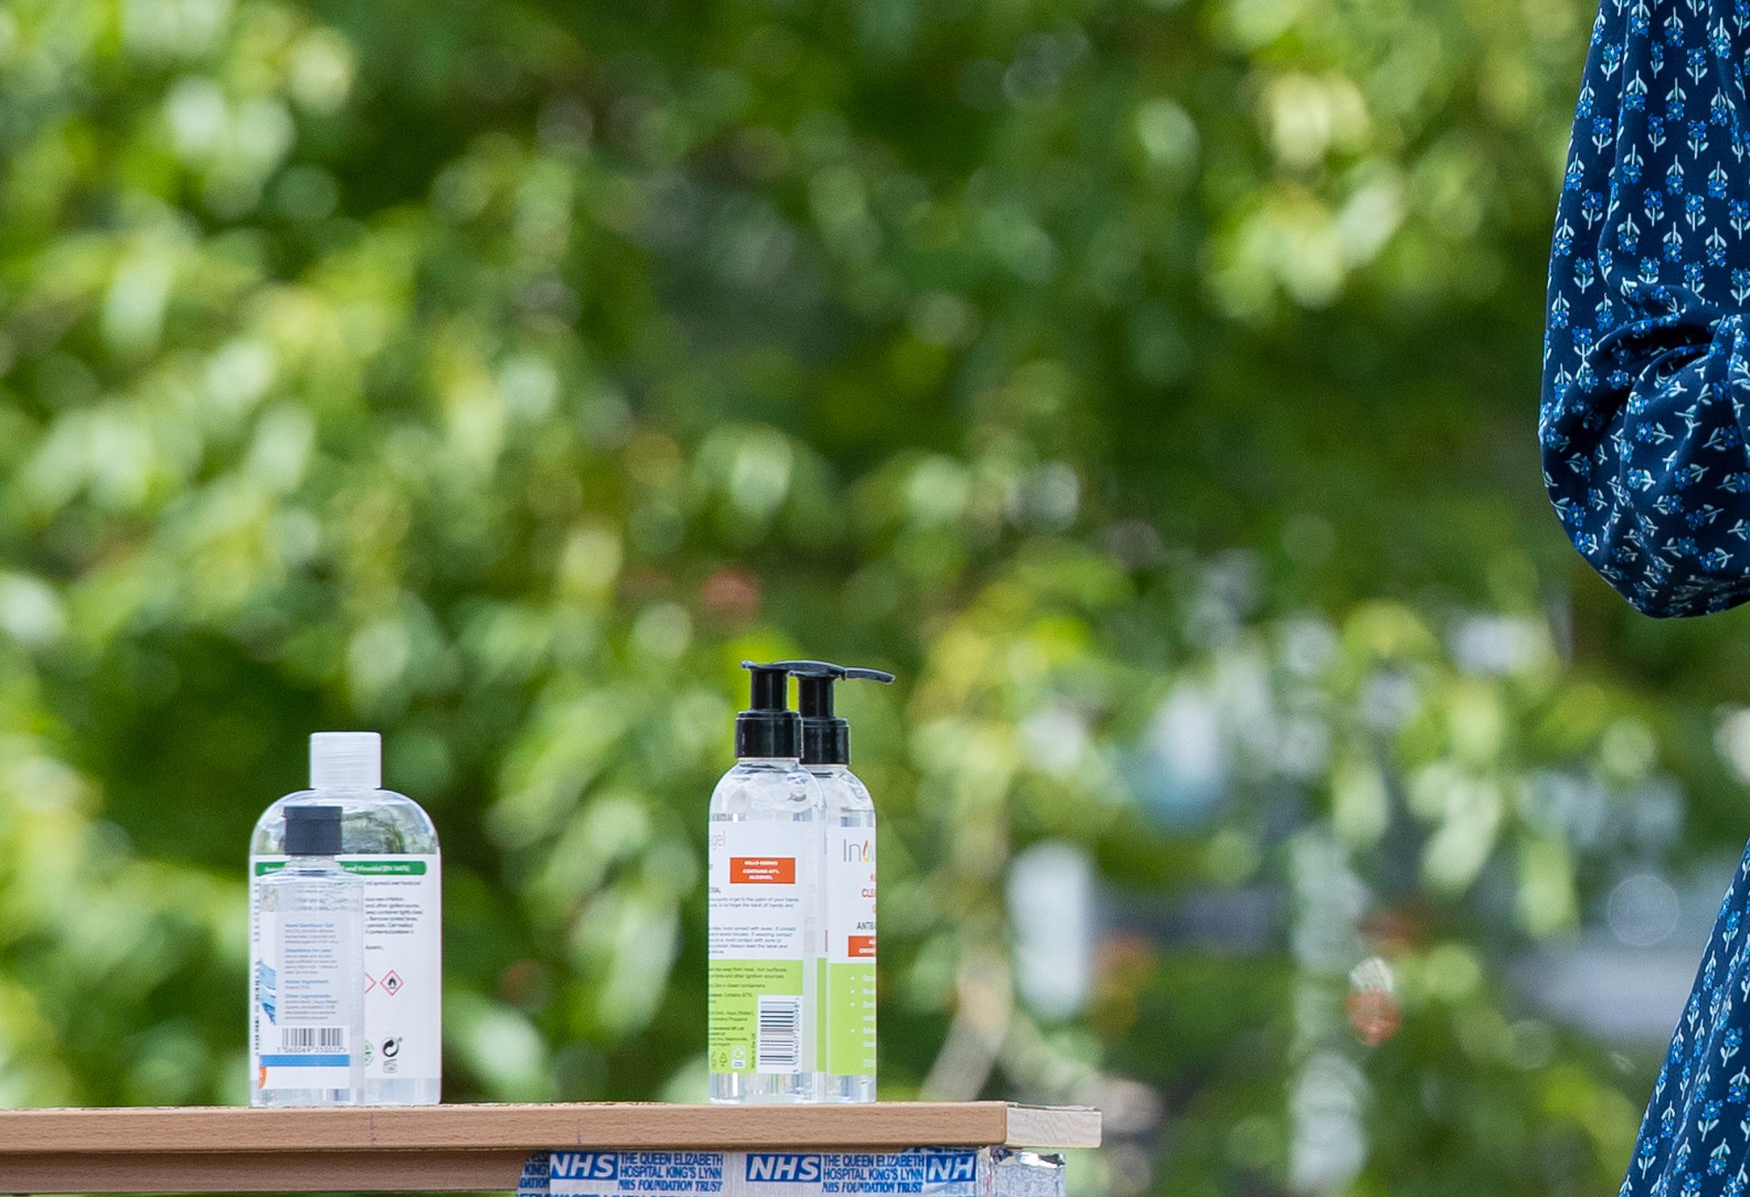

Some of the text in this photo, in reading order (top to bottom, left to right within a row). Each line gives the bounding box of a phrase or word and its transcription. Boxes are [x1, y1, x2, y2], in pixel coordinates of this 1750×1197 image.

[619, 1152, 723, 1166] THE QUEEN ELIZABETH
[822, 1154, 925, 1167] THE QUEEN ELIZABETH
[550, 1154, 615, 1178] NHS
[620, 1165, 722, 1179] HOSPITAL KING'S LYNN
[749, 1155, 819, 1180] NHS
[823, 1167, 924, 1180] HOSPITAL KING'S LYNN
[618, 1179, 723, 1192] NHS FOUNDATION TRUST
[821, 1182, 923, 1193] NHS FOUNDATION TRUST
